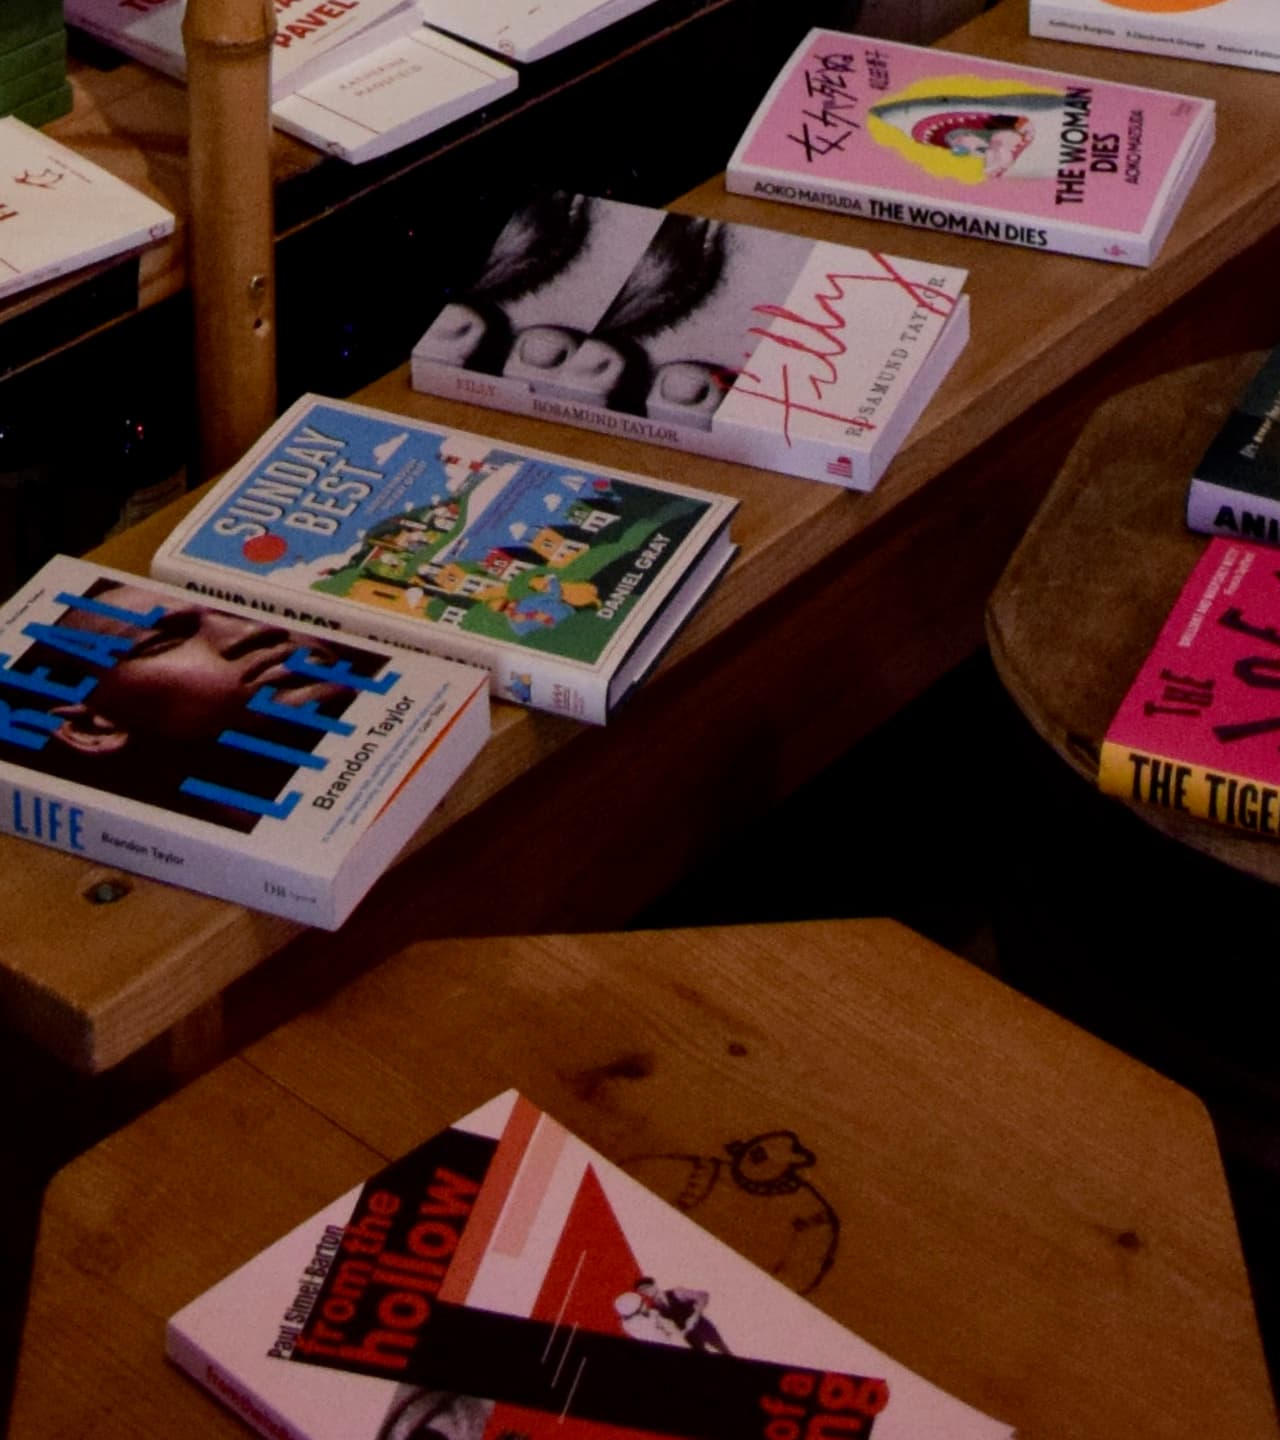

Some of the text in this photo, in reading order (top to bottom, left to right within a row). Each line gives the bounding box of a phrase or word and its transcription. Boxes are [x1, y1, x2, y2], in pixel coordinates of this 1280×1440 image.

[753, 180, 1048, 248] AOKO MATSUDA THE WOMAN DIES
[213, 426, 344, 542] SUNDAY
[284, 457, 388, 538] BEST
[597, 532, 670, 620] DANIEL GRAY
[179, 648, 403, 821] LIFE
[1127, 753, 1194, 813] THE
[339, 1167, 488, 1371] hollow
